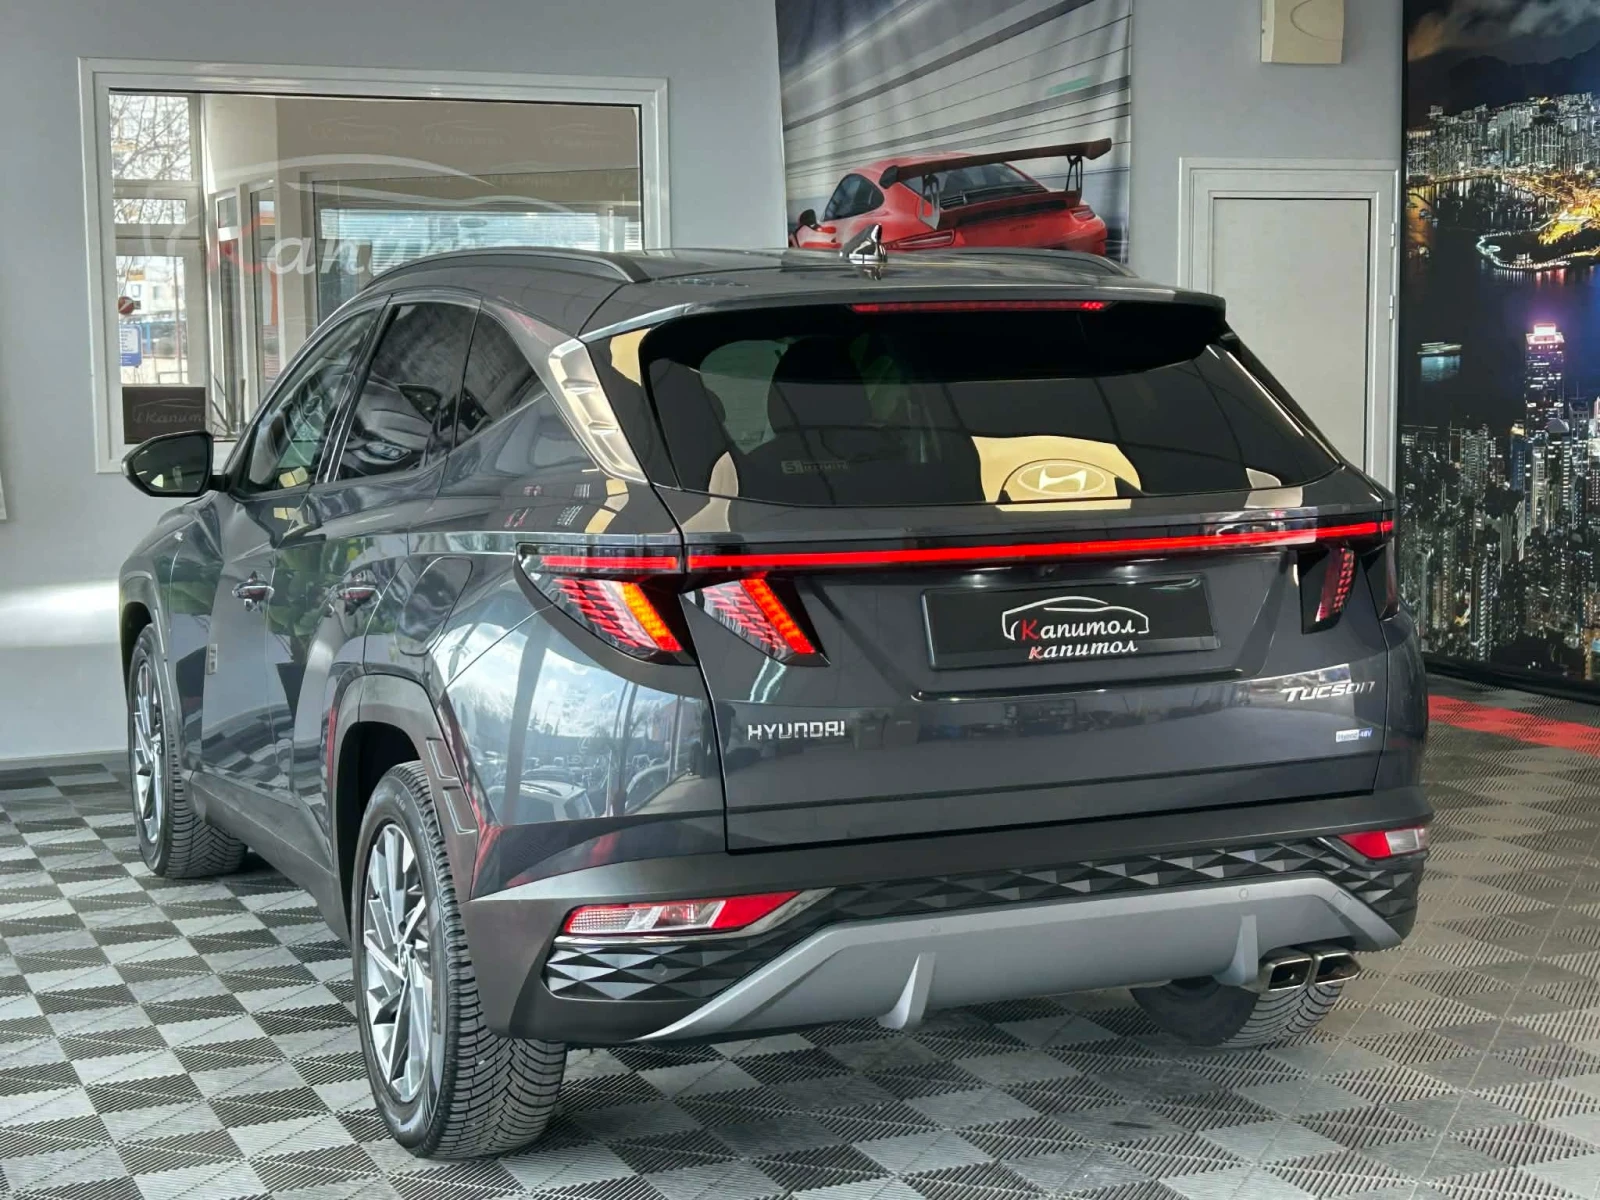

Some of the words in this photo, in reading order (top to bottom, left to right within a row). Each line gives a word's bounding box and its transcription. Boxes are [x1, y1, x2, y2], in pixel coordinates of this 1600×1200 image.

[1020, 619, 1136, 640] Капитол
[1281, 682, 1376, 702] TUCSON
[747, 720, 846, 741] HYUNDAI
